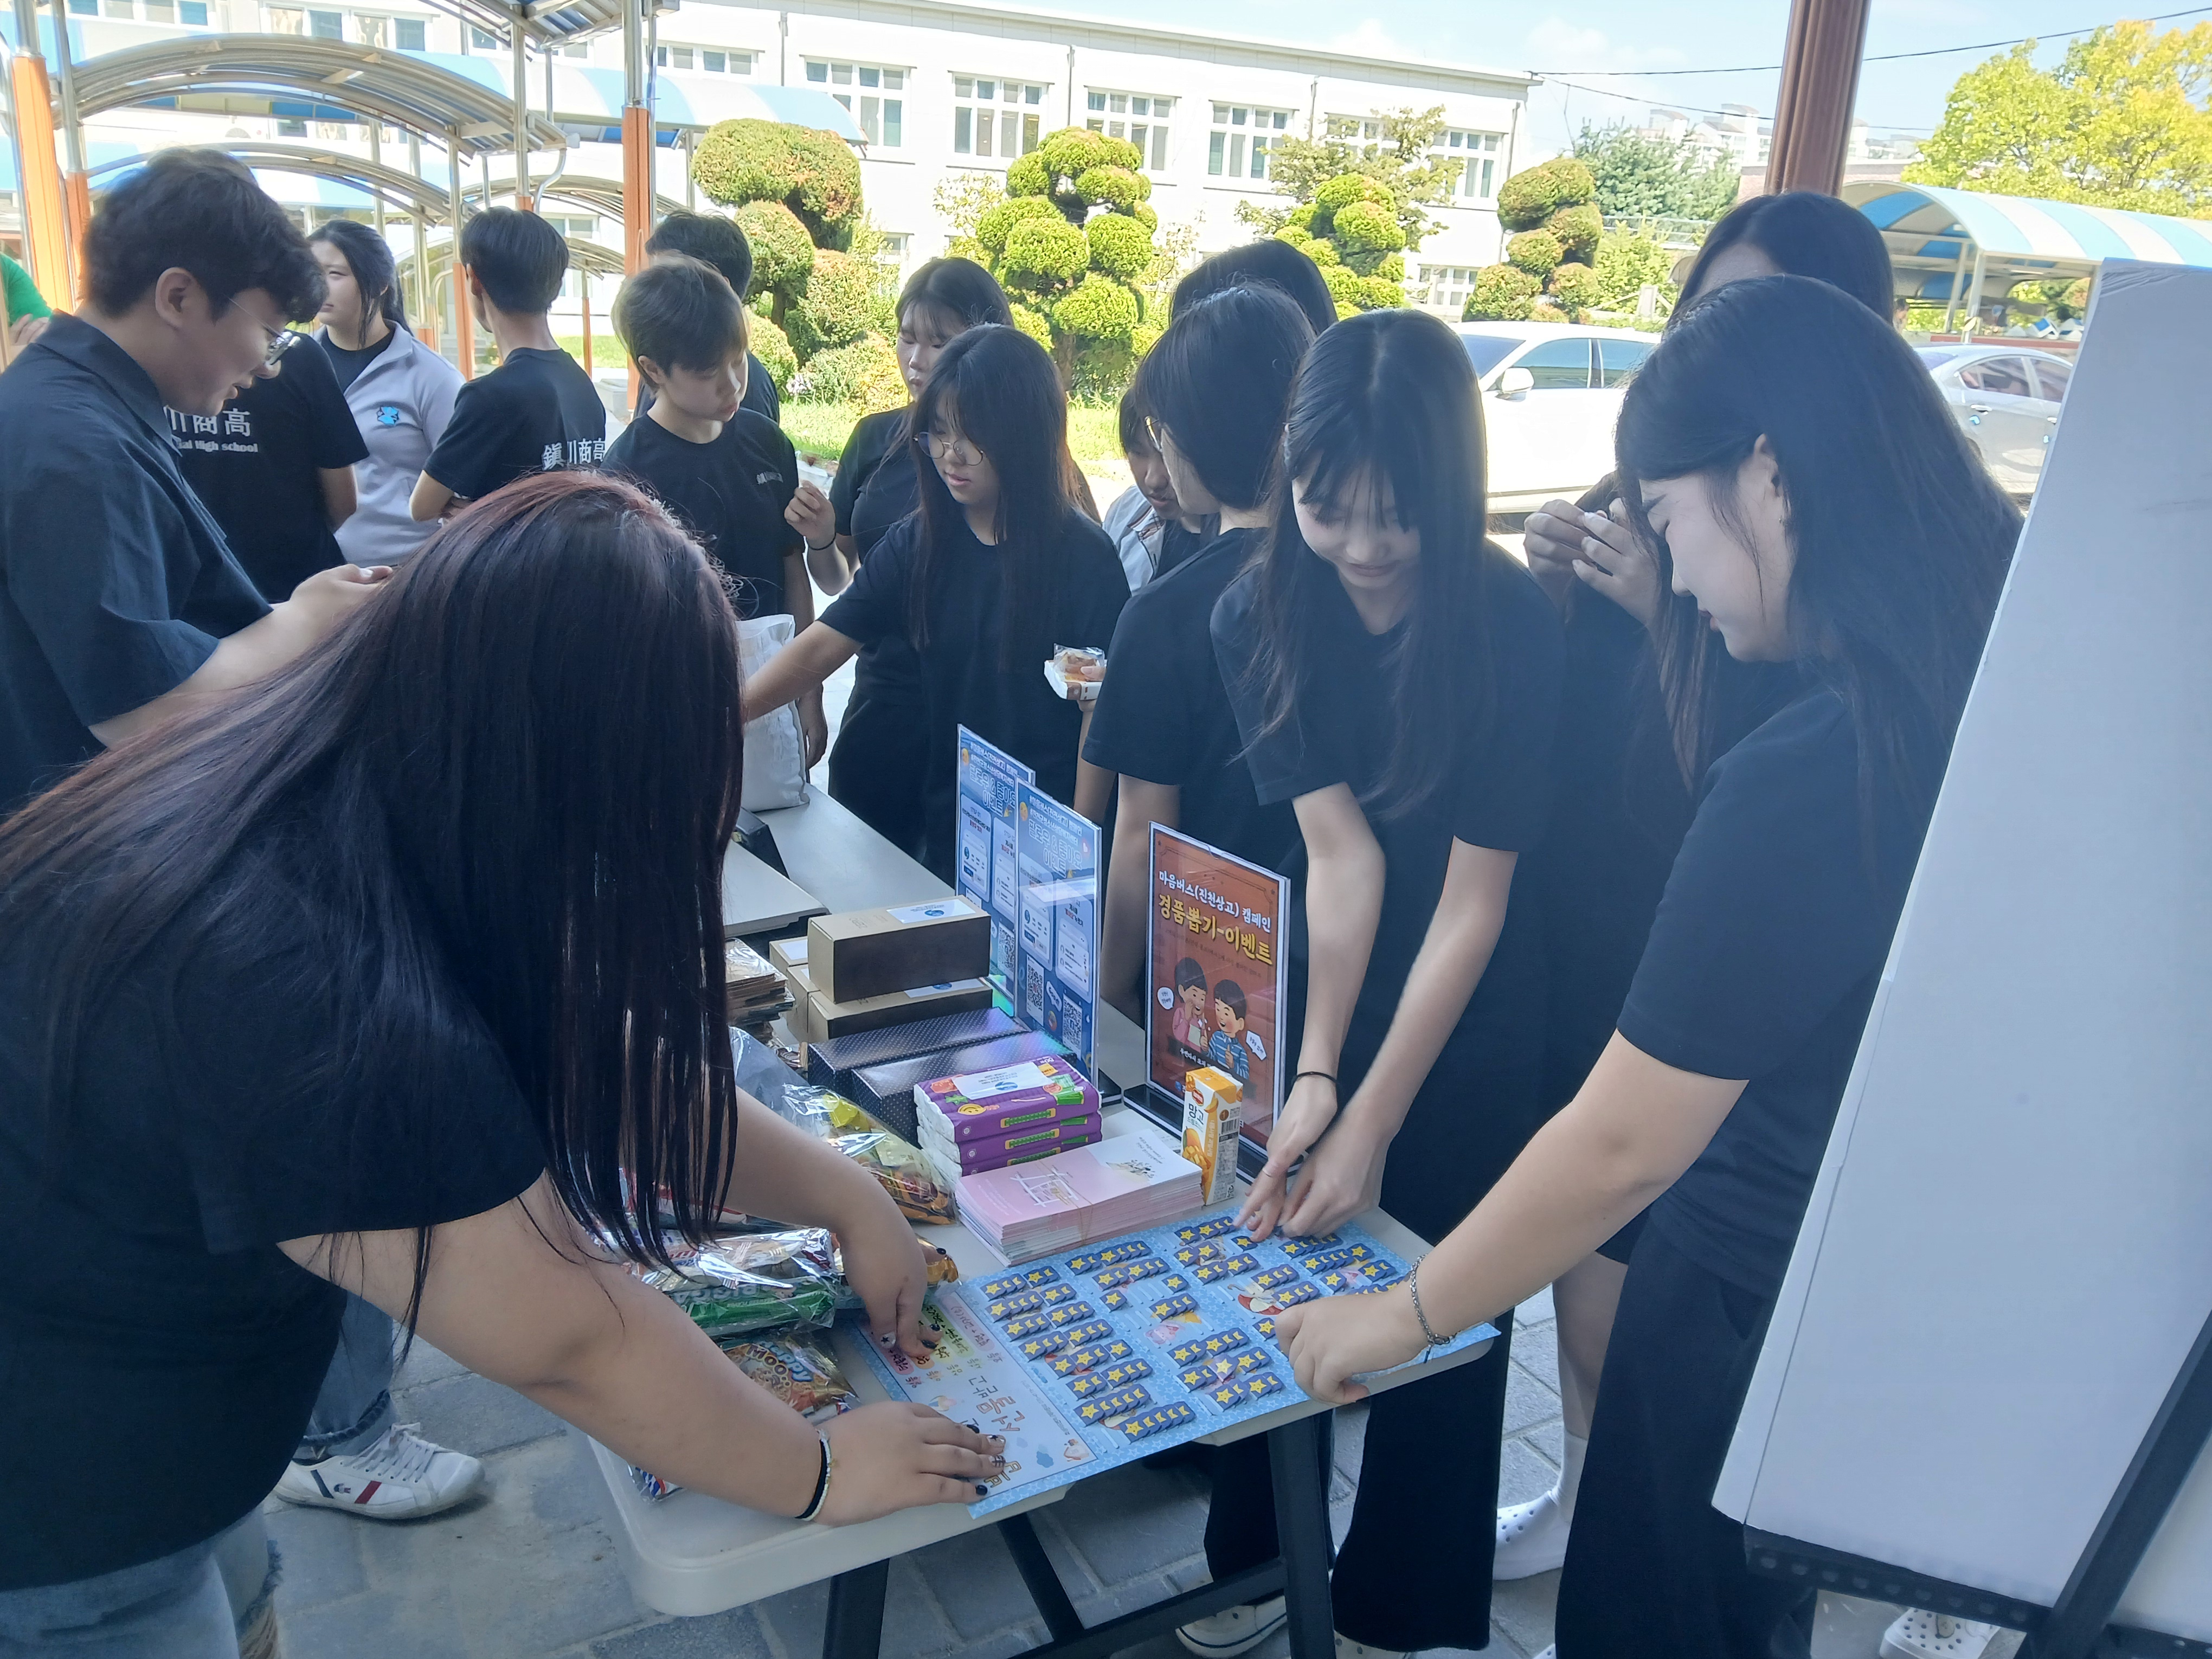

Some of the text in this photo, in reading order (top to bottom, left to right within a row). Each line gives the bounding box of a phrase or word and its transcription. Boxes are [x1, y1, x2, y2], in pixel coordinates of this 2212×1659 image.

[195, 440, 219, 452] High
[221, 442, 258, 453] school
[969, 763, 989, 790] 팔로우
[982, 789, 1003, 818] 이벤트
[1028, 819, 1050, 848] 팔로우
[1058, 839, 1083, 871] 좋아요
[1043, 847, 1066, 879] 이벤트
[1159, 870, 1271, 933] 마음버스(진천상고) 캠페인
[1158, 894, 1273, 965] 경품뽑기-이벤트
[1188, 1103, 1204, 1125] 망고
[968, 1374, 999, 1399] 받고
[975, 1394, 1025, 1433] 선물
